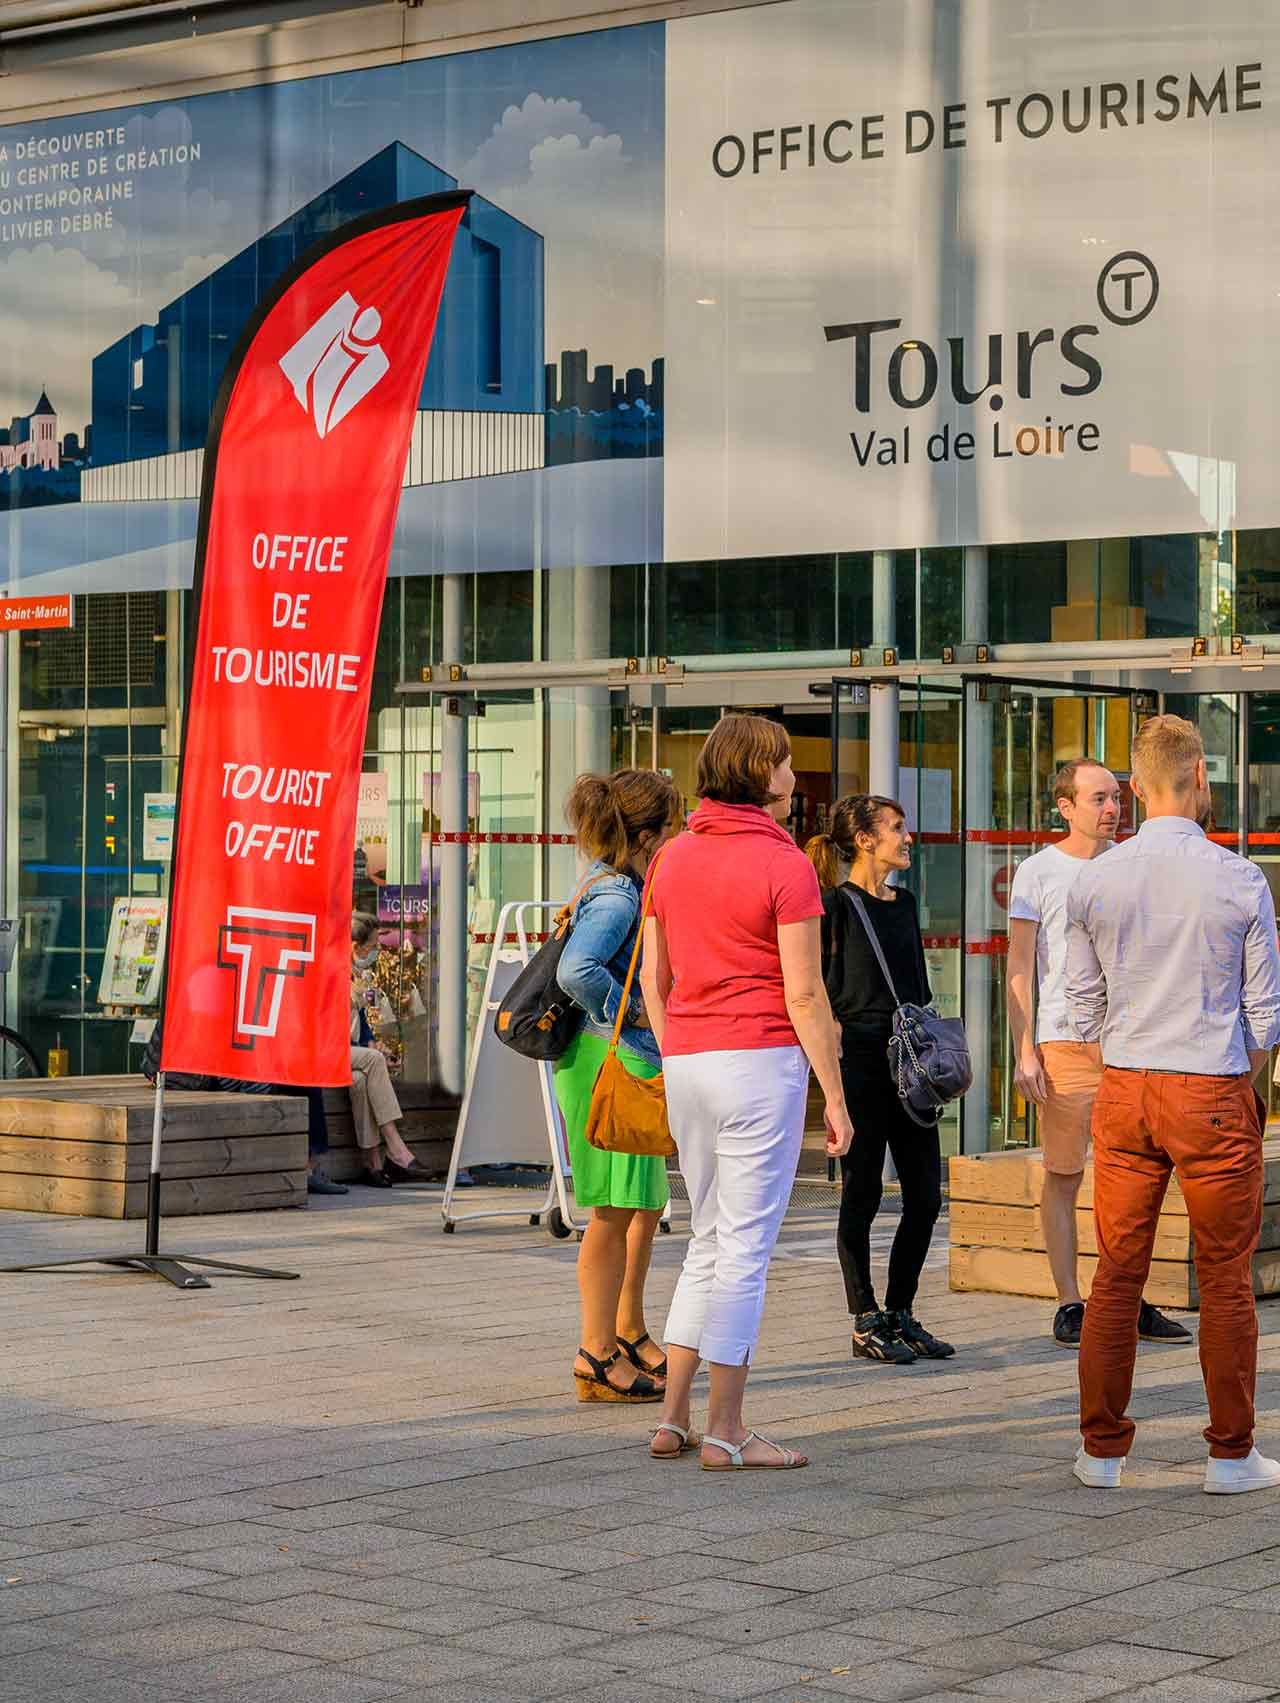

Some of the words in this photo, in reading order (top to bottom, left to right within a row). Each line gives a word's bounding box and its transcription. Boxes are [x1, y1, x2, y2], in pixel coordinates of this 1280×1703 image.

[712, 114, 884, 178] OFFICE
[906, 103, 967, 154] DE
[987, 62, 1262, 143] TOURISME
[16, 127, 126, 160] DÉCOUVERTE
[17, 161, 80, 186] CENTRE
[88, 157, 108, 177] DE
[115, 143, 201, 172] CRÉATION
[60, 206, 113, 233] DEBRÉ
[823, 317, 1103, 413] Tours
[850, 425, 910, 468] Val
[927, 421, 975, 463] de
[993, 416, 1100, 459] Loire
[252, 532, 348, 573] OFFICE
[271, 591, 310, 630] DE
[212, 646, 361, 692] TOURISME
[221, 762, 332, 808] TOURIST
[225, 820, 320, 866] OFFICE
[384, 898, 430, 914] TOURS
